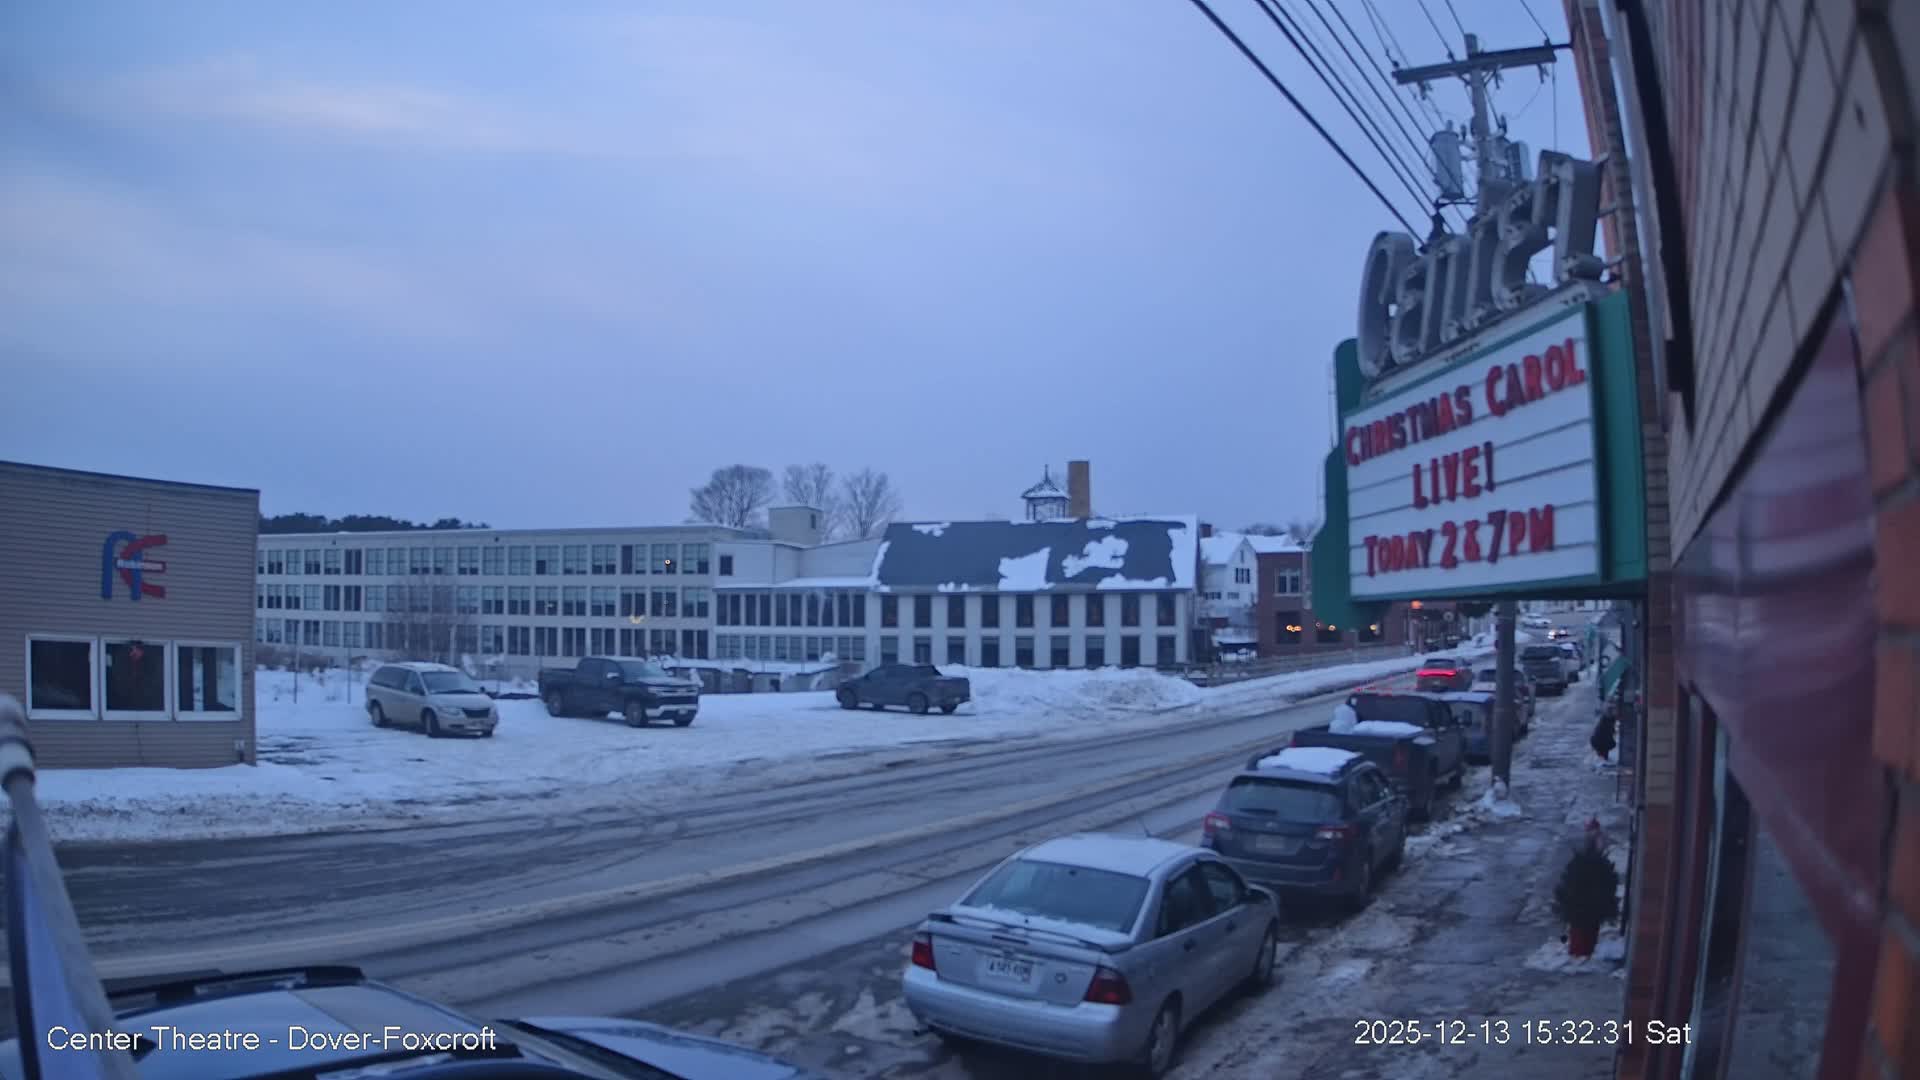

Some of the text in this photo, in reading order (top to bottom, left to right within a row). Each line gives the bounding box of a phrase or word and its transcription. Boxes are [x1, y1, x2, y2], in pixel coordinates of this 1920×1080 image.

[1345, 337, 1586, 467] CHRISTMAS CAROL
[1411, 441, 1496, 510] LIVE!
[1364, 528, 1434, 578] TODAY
